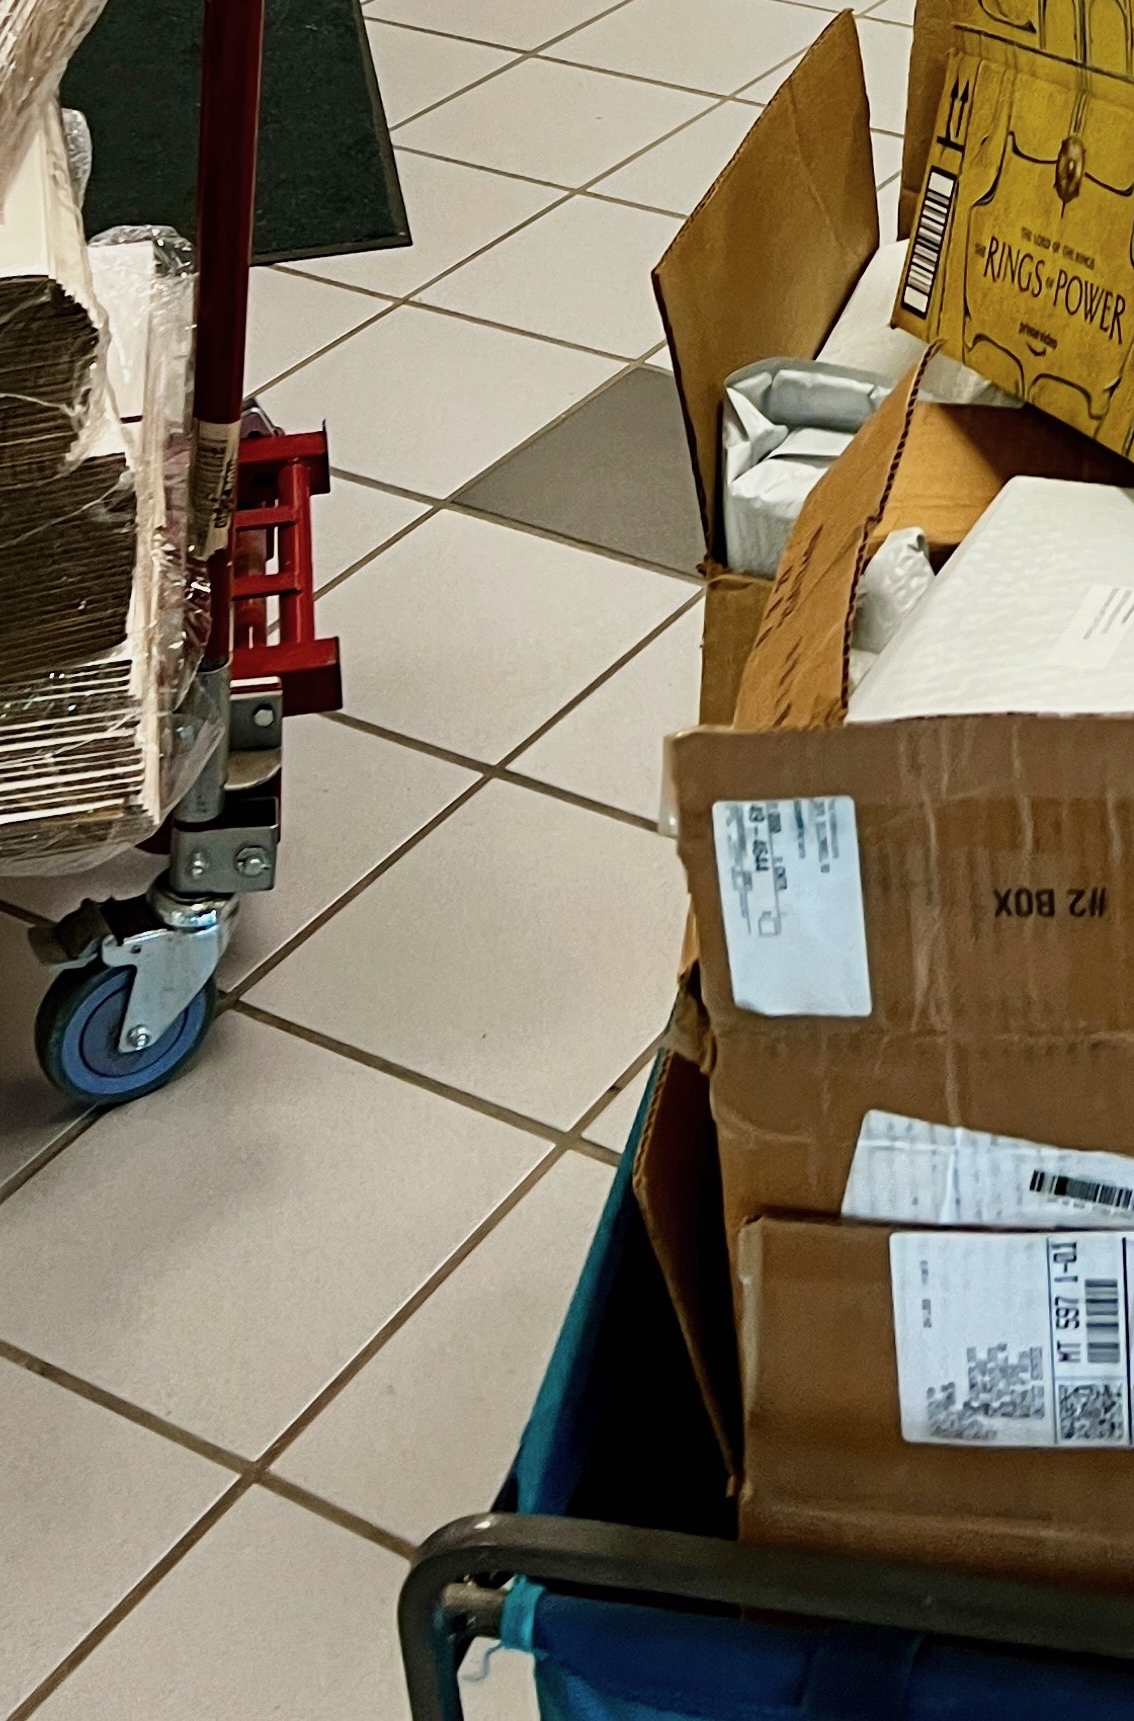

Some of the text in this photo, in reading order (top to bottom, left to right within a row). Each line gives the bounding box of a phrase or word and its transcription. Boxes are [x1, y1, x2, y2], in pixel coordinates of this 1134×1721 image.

[984, 236, 1045, 298] RINGS
[1053, 269, 1126, 345] POWER
[993, 888, 1055, 919] BOX
